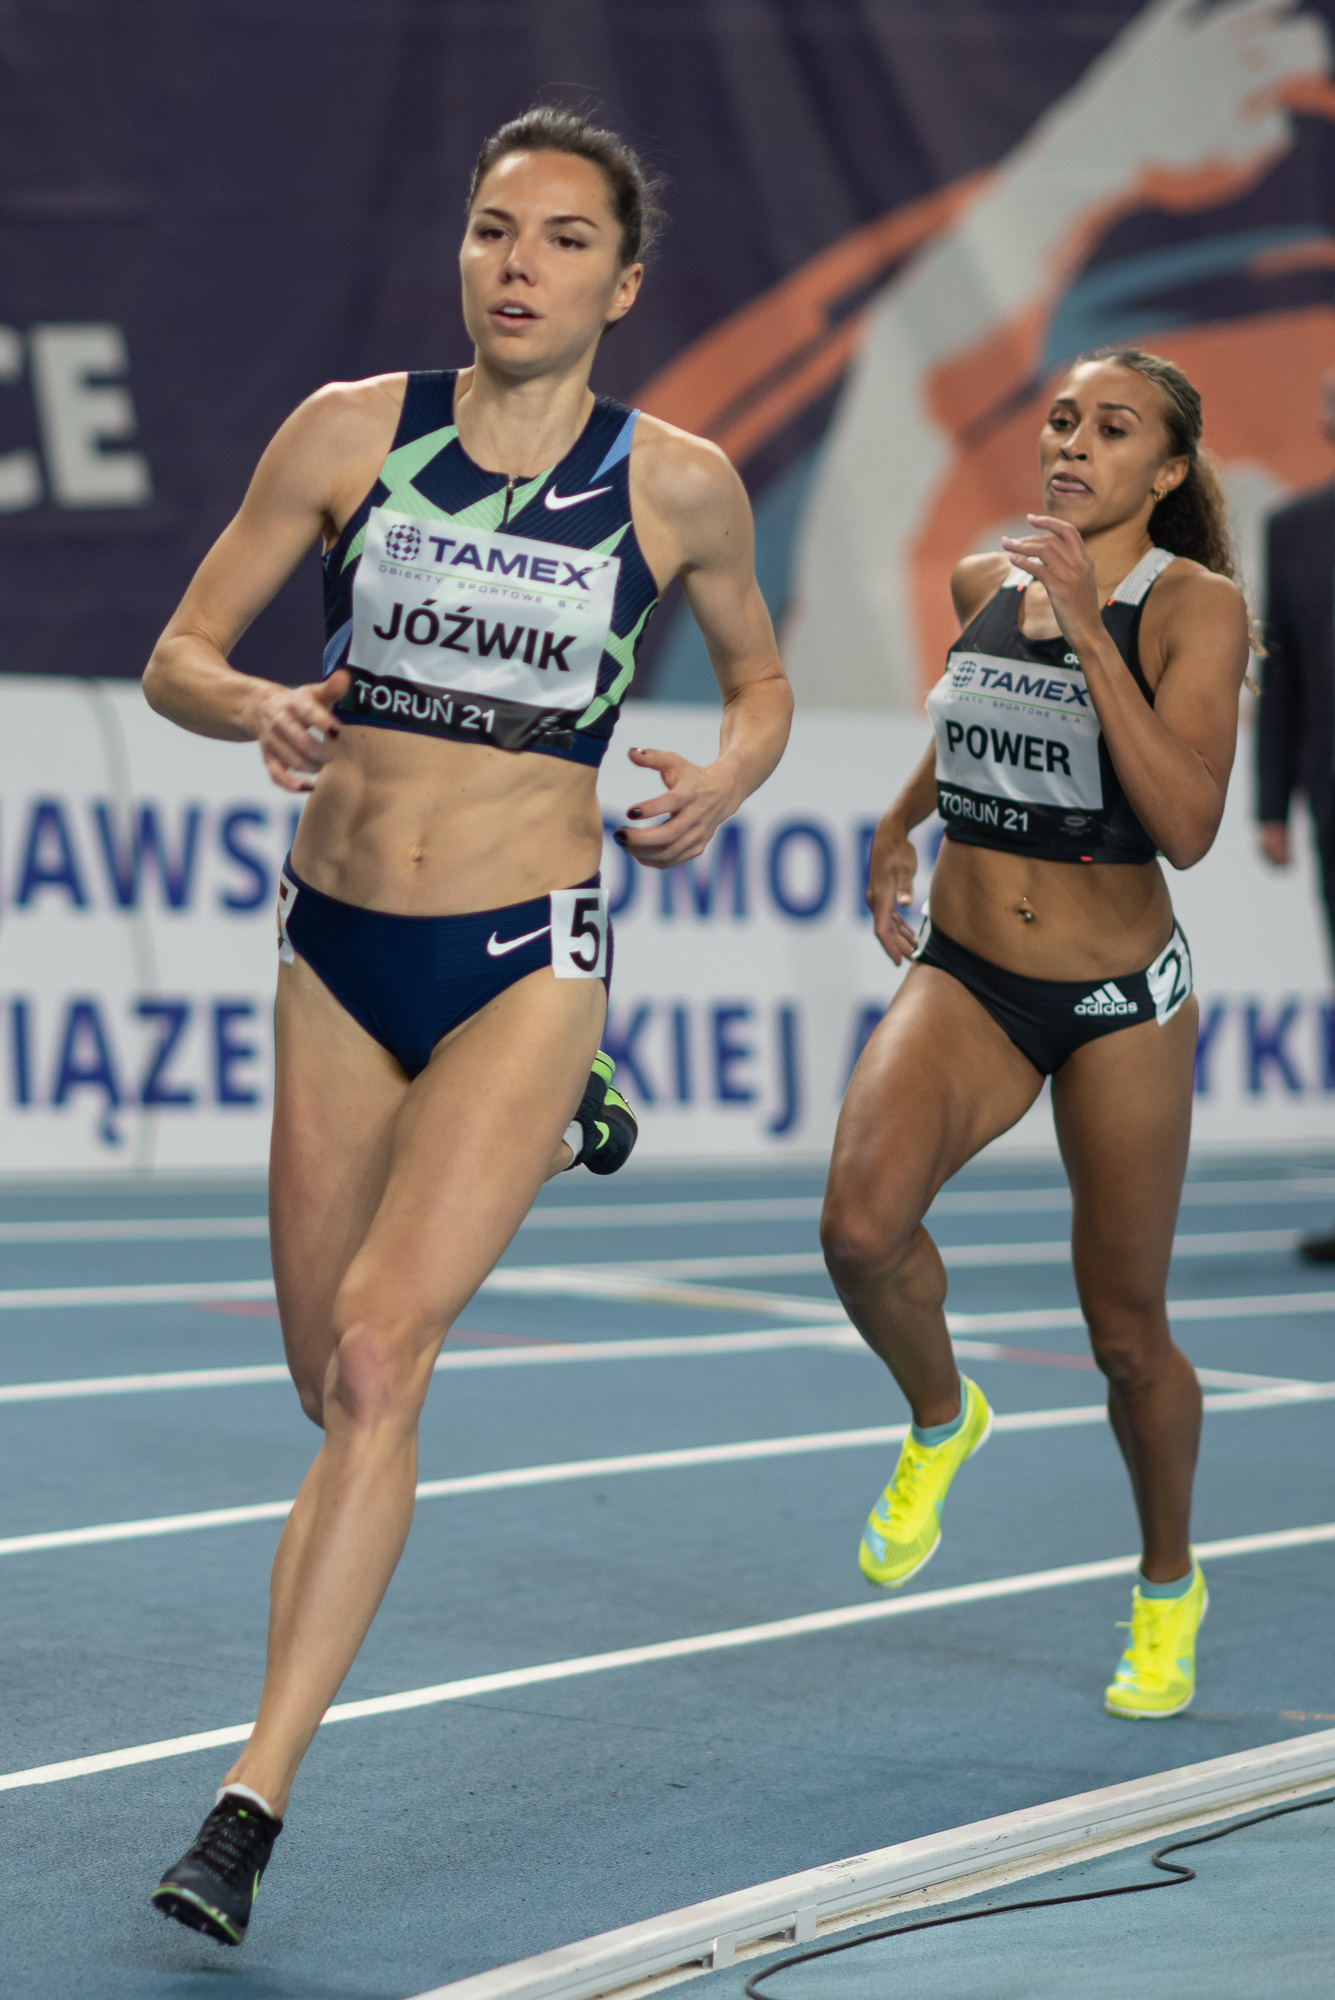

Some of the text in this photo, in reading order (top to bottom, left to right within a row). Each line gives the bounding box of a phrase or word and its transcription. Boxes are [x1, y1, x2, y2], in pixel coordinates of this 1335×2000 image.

[379, 564, 443, 583] OBIEKTY
[457, 581, 543, 603] SPORTOWE
[429, 535, 593, 590] TAMEX
[373, 599, 578, 672] JÓŹWIK
[355, 680, 496, 733] TORUŃ 21
[980, 667, 1088, 707] TAMEX
[945, 719, 1072, 776] POWER
[940, 790, 1028, 832] TORUŃ 21
[569, 897, 601, 972] 5
[1158, 947, 1186, 1013] 2
[1074, 1001, 1138, 1016] adidas
